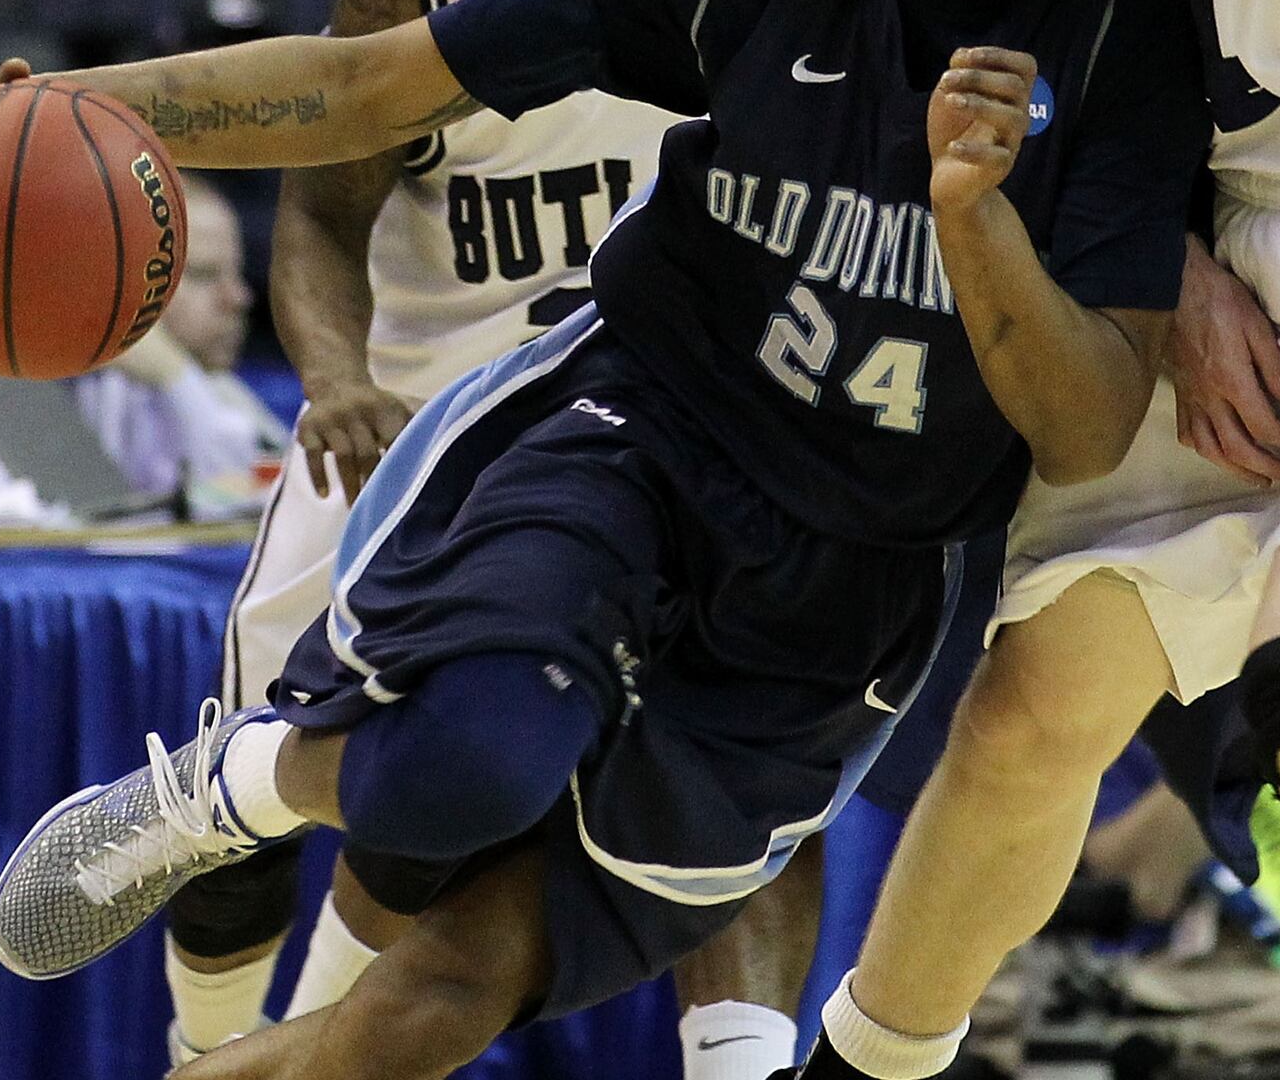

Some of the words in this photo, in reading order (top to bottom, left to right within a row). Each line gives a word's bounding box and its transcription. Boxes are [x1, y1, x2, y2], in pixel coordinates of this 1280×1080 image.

[114, 151, 175, 356] Wilson
[706, 167, 812, 258] OLD
[755, 280, 929, 434] 24
